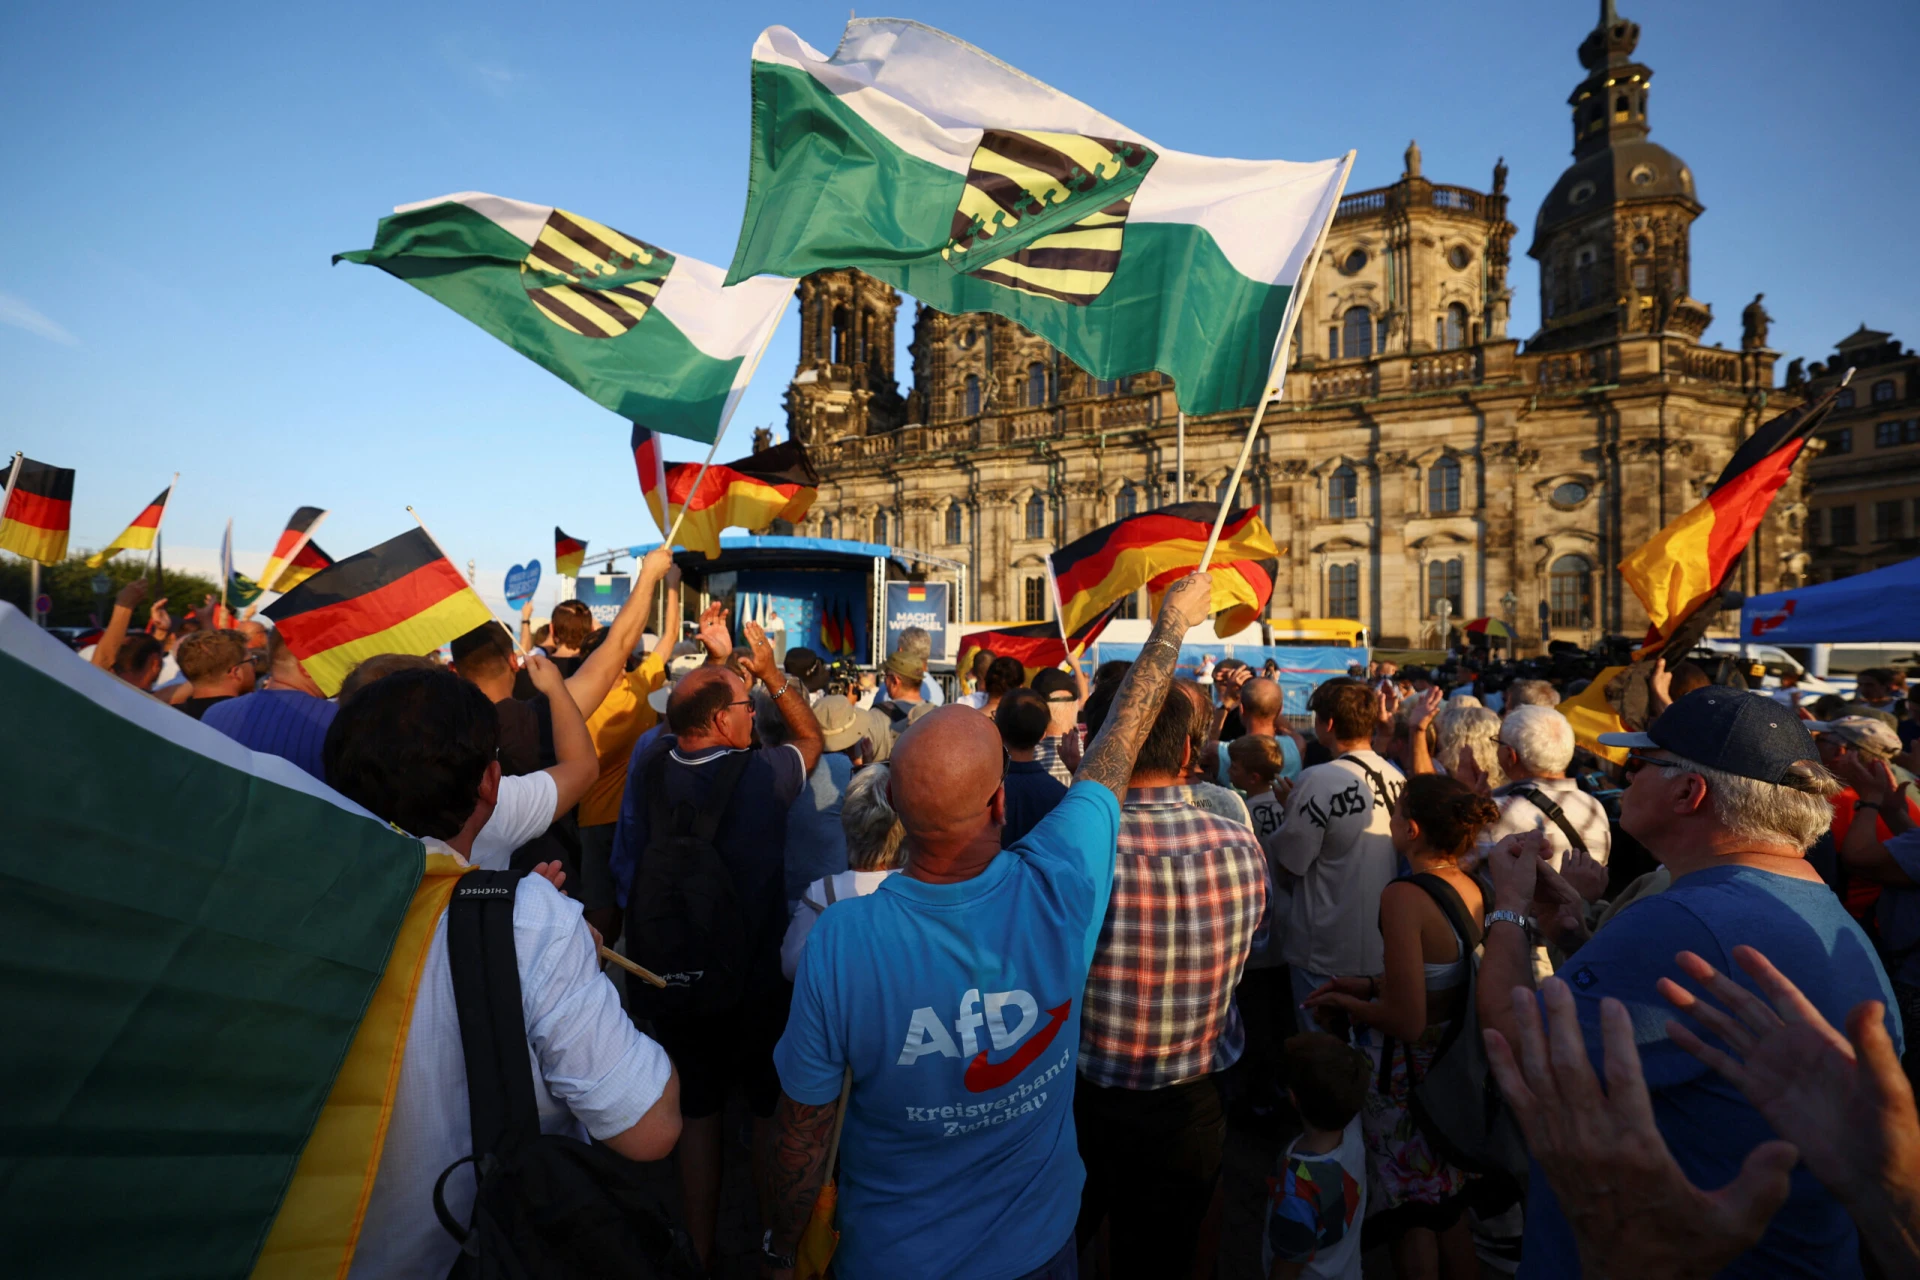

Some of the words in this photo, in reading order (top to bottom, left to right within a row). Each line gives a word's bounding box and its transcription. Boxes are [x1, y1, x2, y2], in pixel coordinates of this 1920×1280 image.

[896, 611, 937, 622] MACHT
[1191, 799, 1213, 808] DAVID
[1300, 780, 1366, 828] Los
[459, 887, 509, 896] CHIEMSEE
[896, 988, 1039, 1066] AfD
[906, 1048, 1070, 1122] Kreisverband
[943, 1092, 1048, 1138] Zwickau
